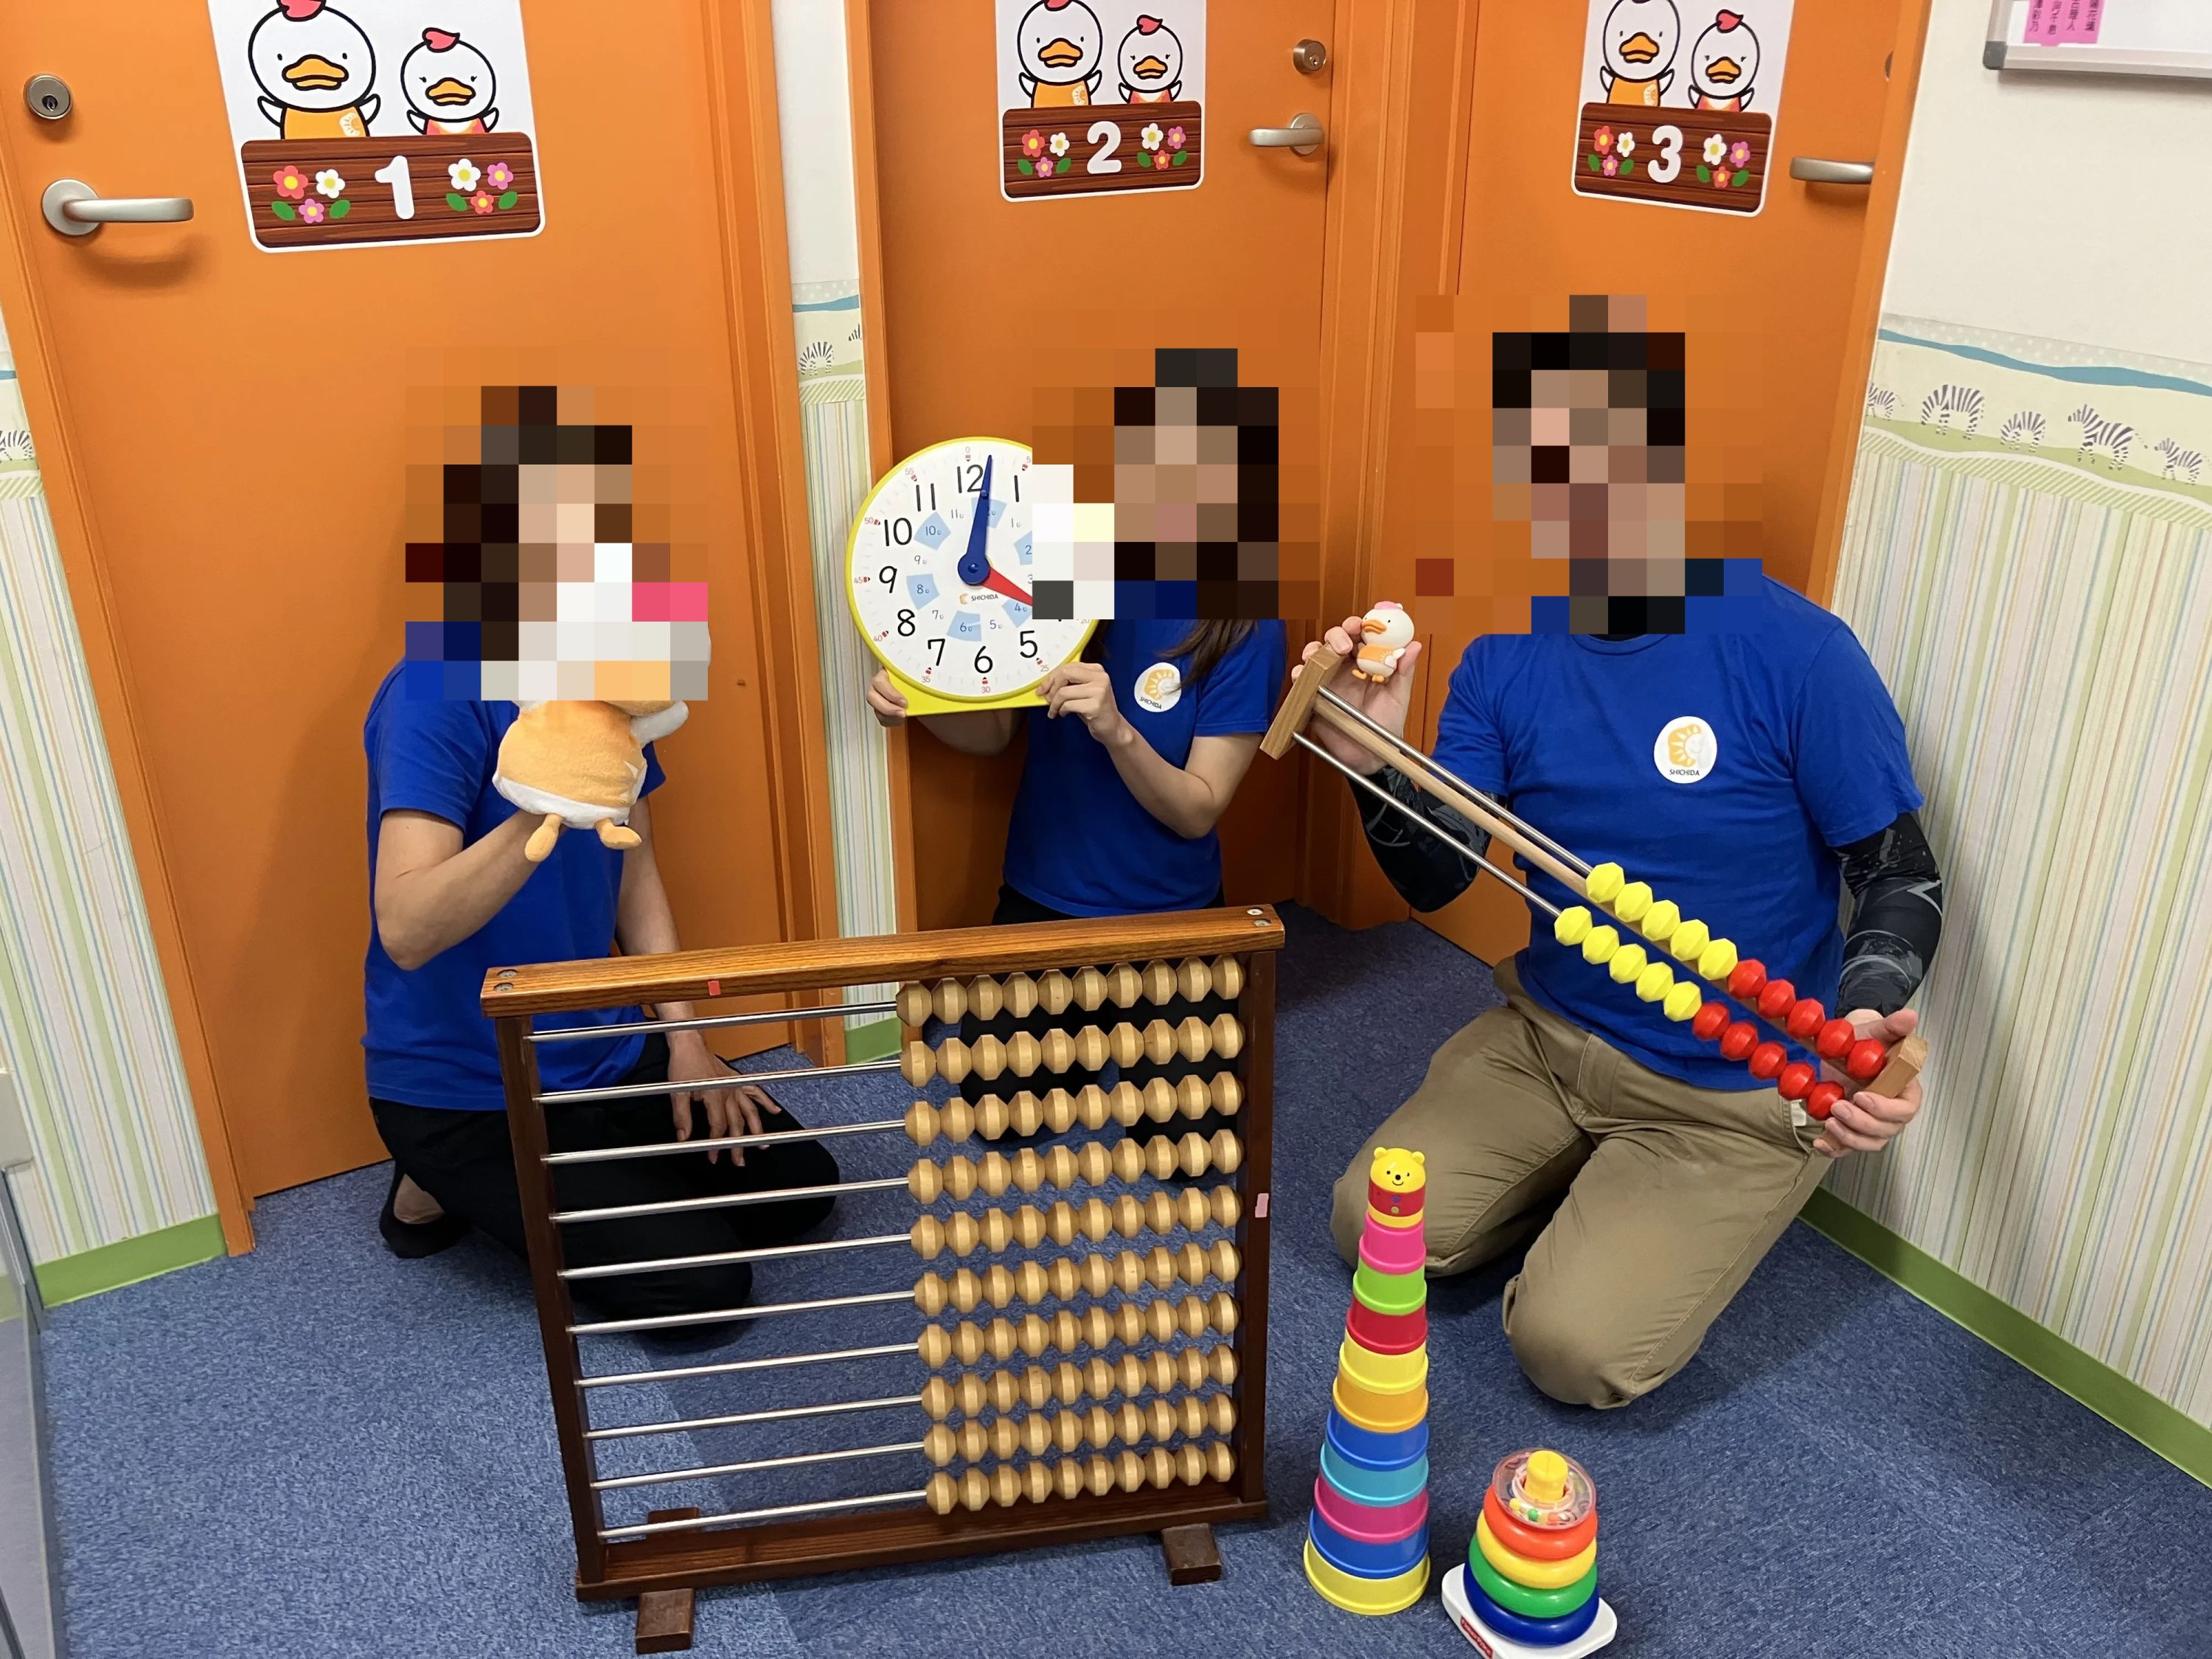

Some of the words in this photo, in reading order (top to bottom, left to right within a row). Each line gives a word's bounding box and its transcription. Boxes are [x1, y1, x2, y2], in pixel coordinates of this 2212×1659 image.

[1086, 120, 1122, 175] 2
[1647, 125, 1683, 184] 3
[375, 155, 415, 220] 1
[957, 464, 984, 493] 12
[1014, 475, 1020, 502] 1
[916, 483, 936, 512] 11
[884, 518, 912, 546] 10
[879, 566, 897, 594] 9
[897, 609, 915, 637] 8
[928, 639, 945, 667] 7
[1020, 630, 1038, 658] 5
[974, 646, 993, 674] 6
[1139, 696, 1162, 709] SHICHIDA
